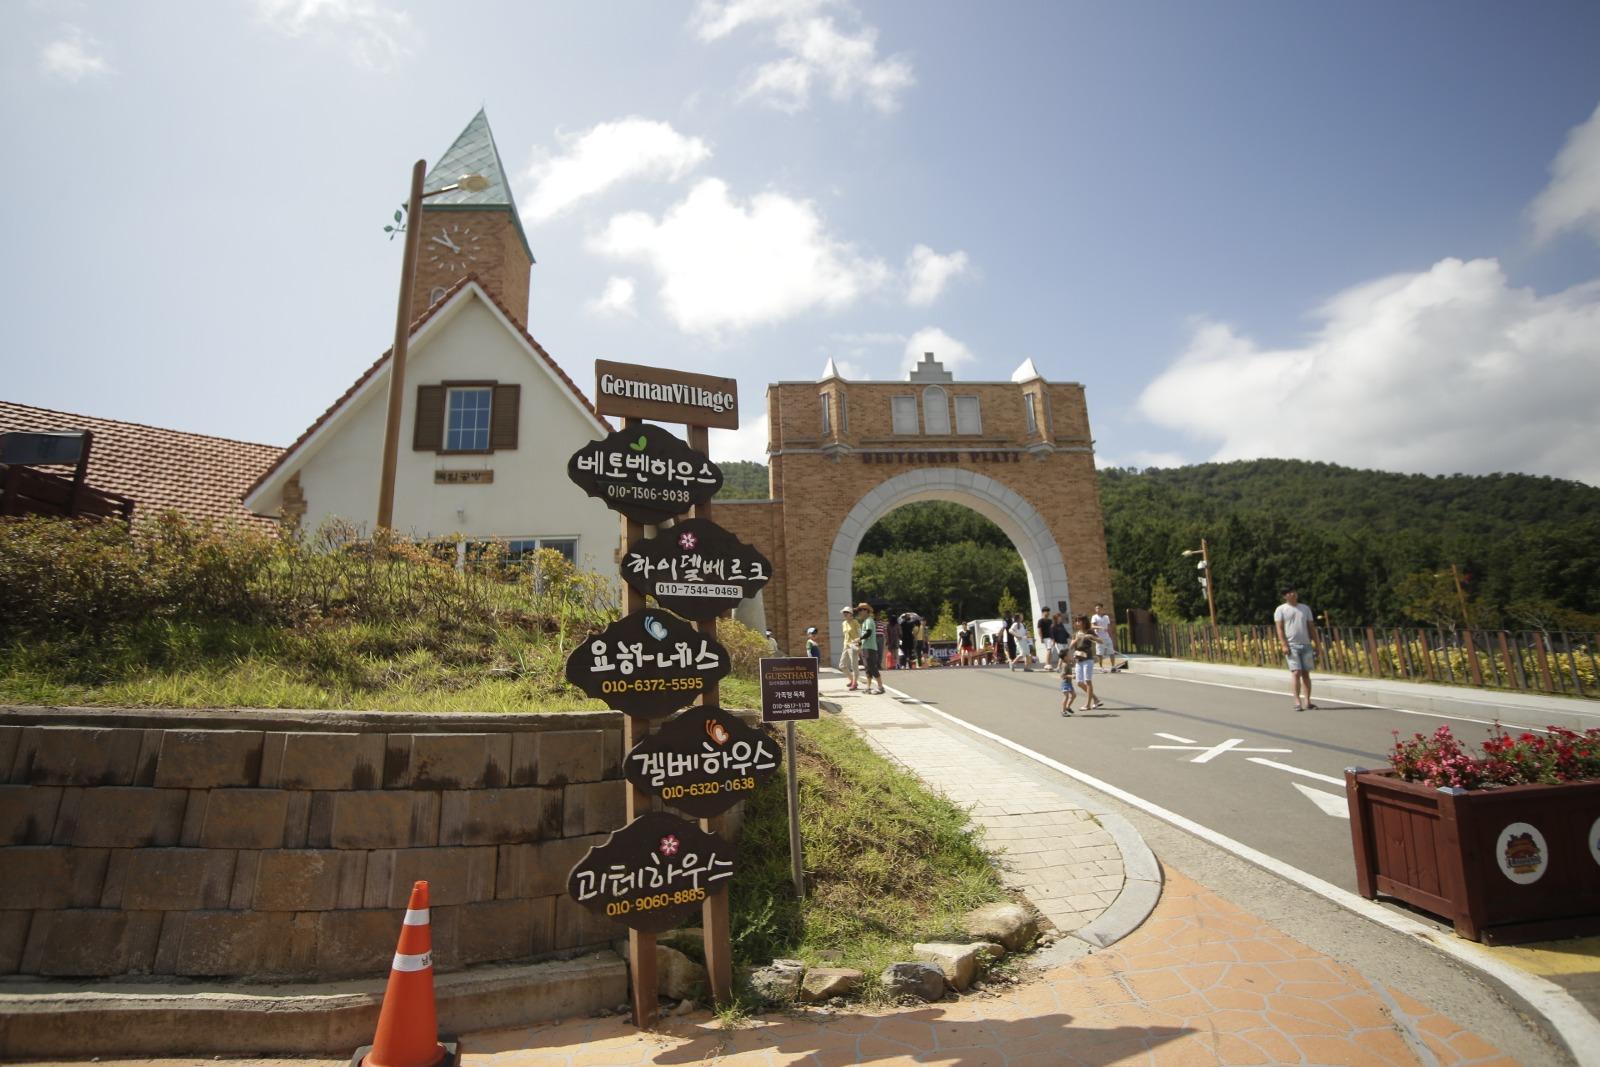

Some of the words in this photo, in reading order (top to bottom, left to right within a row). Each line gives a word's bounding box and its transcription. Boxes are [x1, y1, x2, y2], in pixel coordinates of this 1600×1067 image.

[600, 373, 734, 413] GermanVillage
[577, 450, 717, 486] 베토벤하우스
[607, 484, 690, 503] 010-7506-9038
[627, 552, 769, 582] 하이델베르크
[658, 584, 739, 596] 010-7544-0469
[602, 677, 704, 693] 010-6372-5595
[765, 672, 816, 680] GUESTHAUS
[632, 740, 776, 787] 겔베하우스
[662, 777, 755, 800] 010-6320-0638
[606, 887, 706, 916] 010-9060-8885
